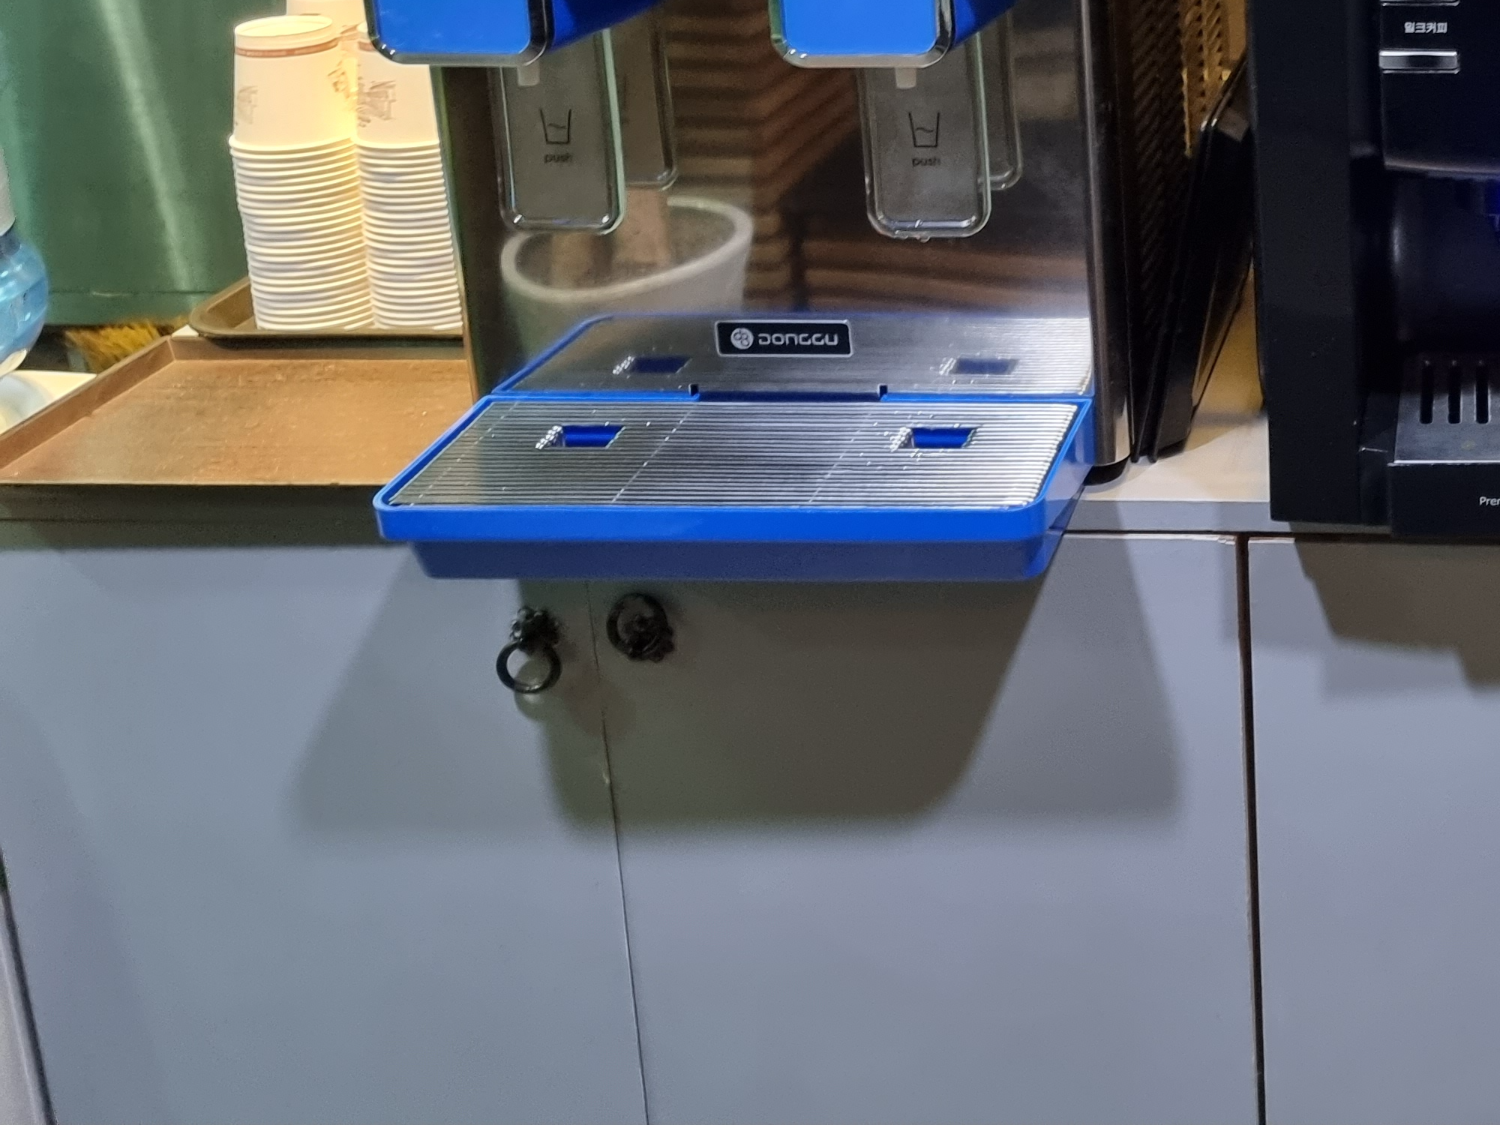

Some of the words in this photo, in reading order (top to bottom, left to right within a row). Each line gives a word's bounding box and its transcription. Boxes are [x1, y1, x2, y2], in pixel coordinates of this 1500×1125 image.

[1404, 21, 1448, 34] 밀크커피
[544, 152, 573, 164] push
[912, 156, 941, 168] push
[758, 333, 839, 346] DONGGU
